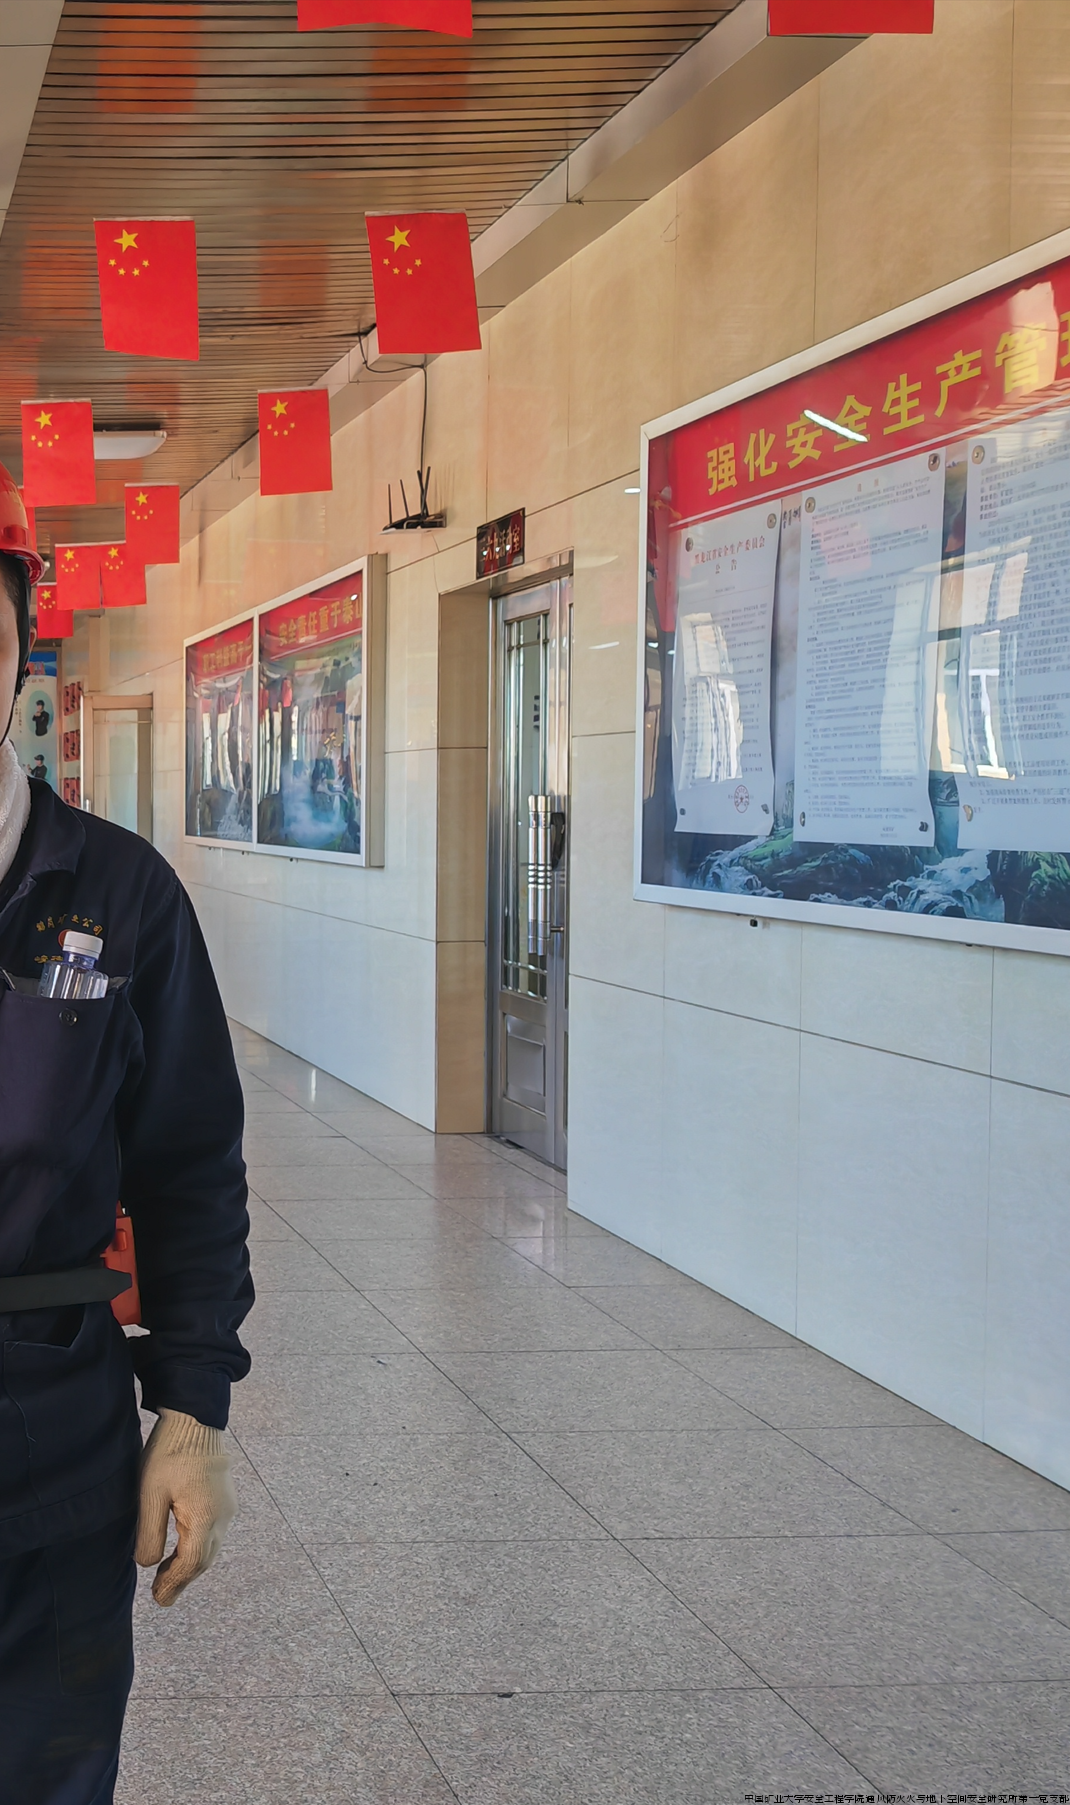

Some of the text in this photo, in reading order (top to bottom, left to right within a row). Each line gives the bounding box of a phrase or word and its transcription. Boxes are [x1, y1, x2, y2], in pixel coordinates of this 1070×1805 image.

[706, 311, 1070, 495] 强化安全生产管
